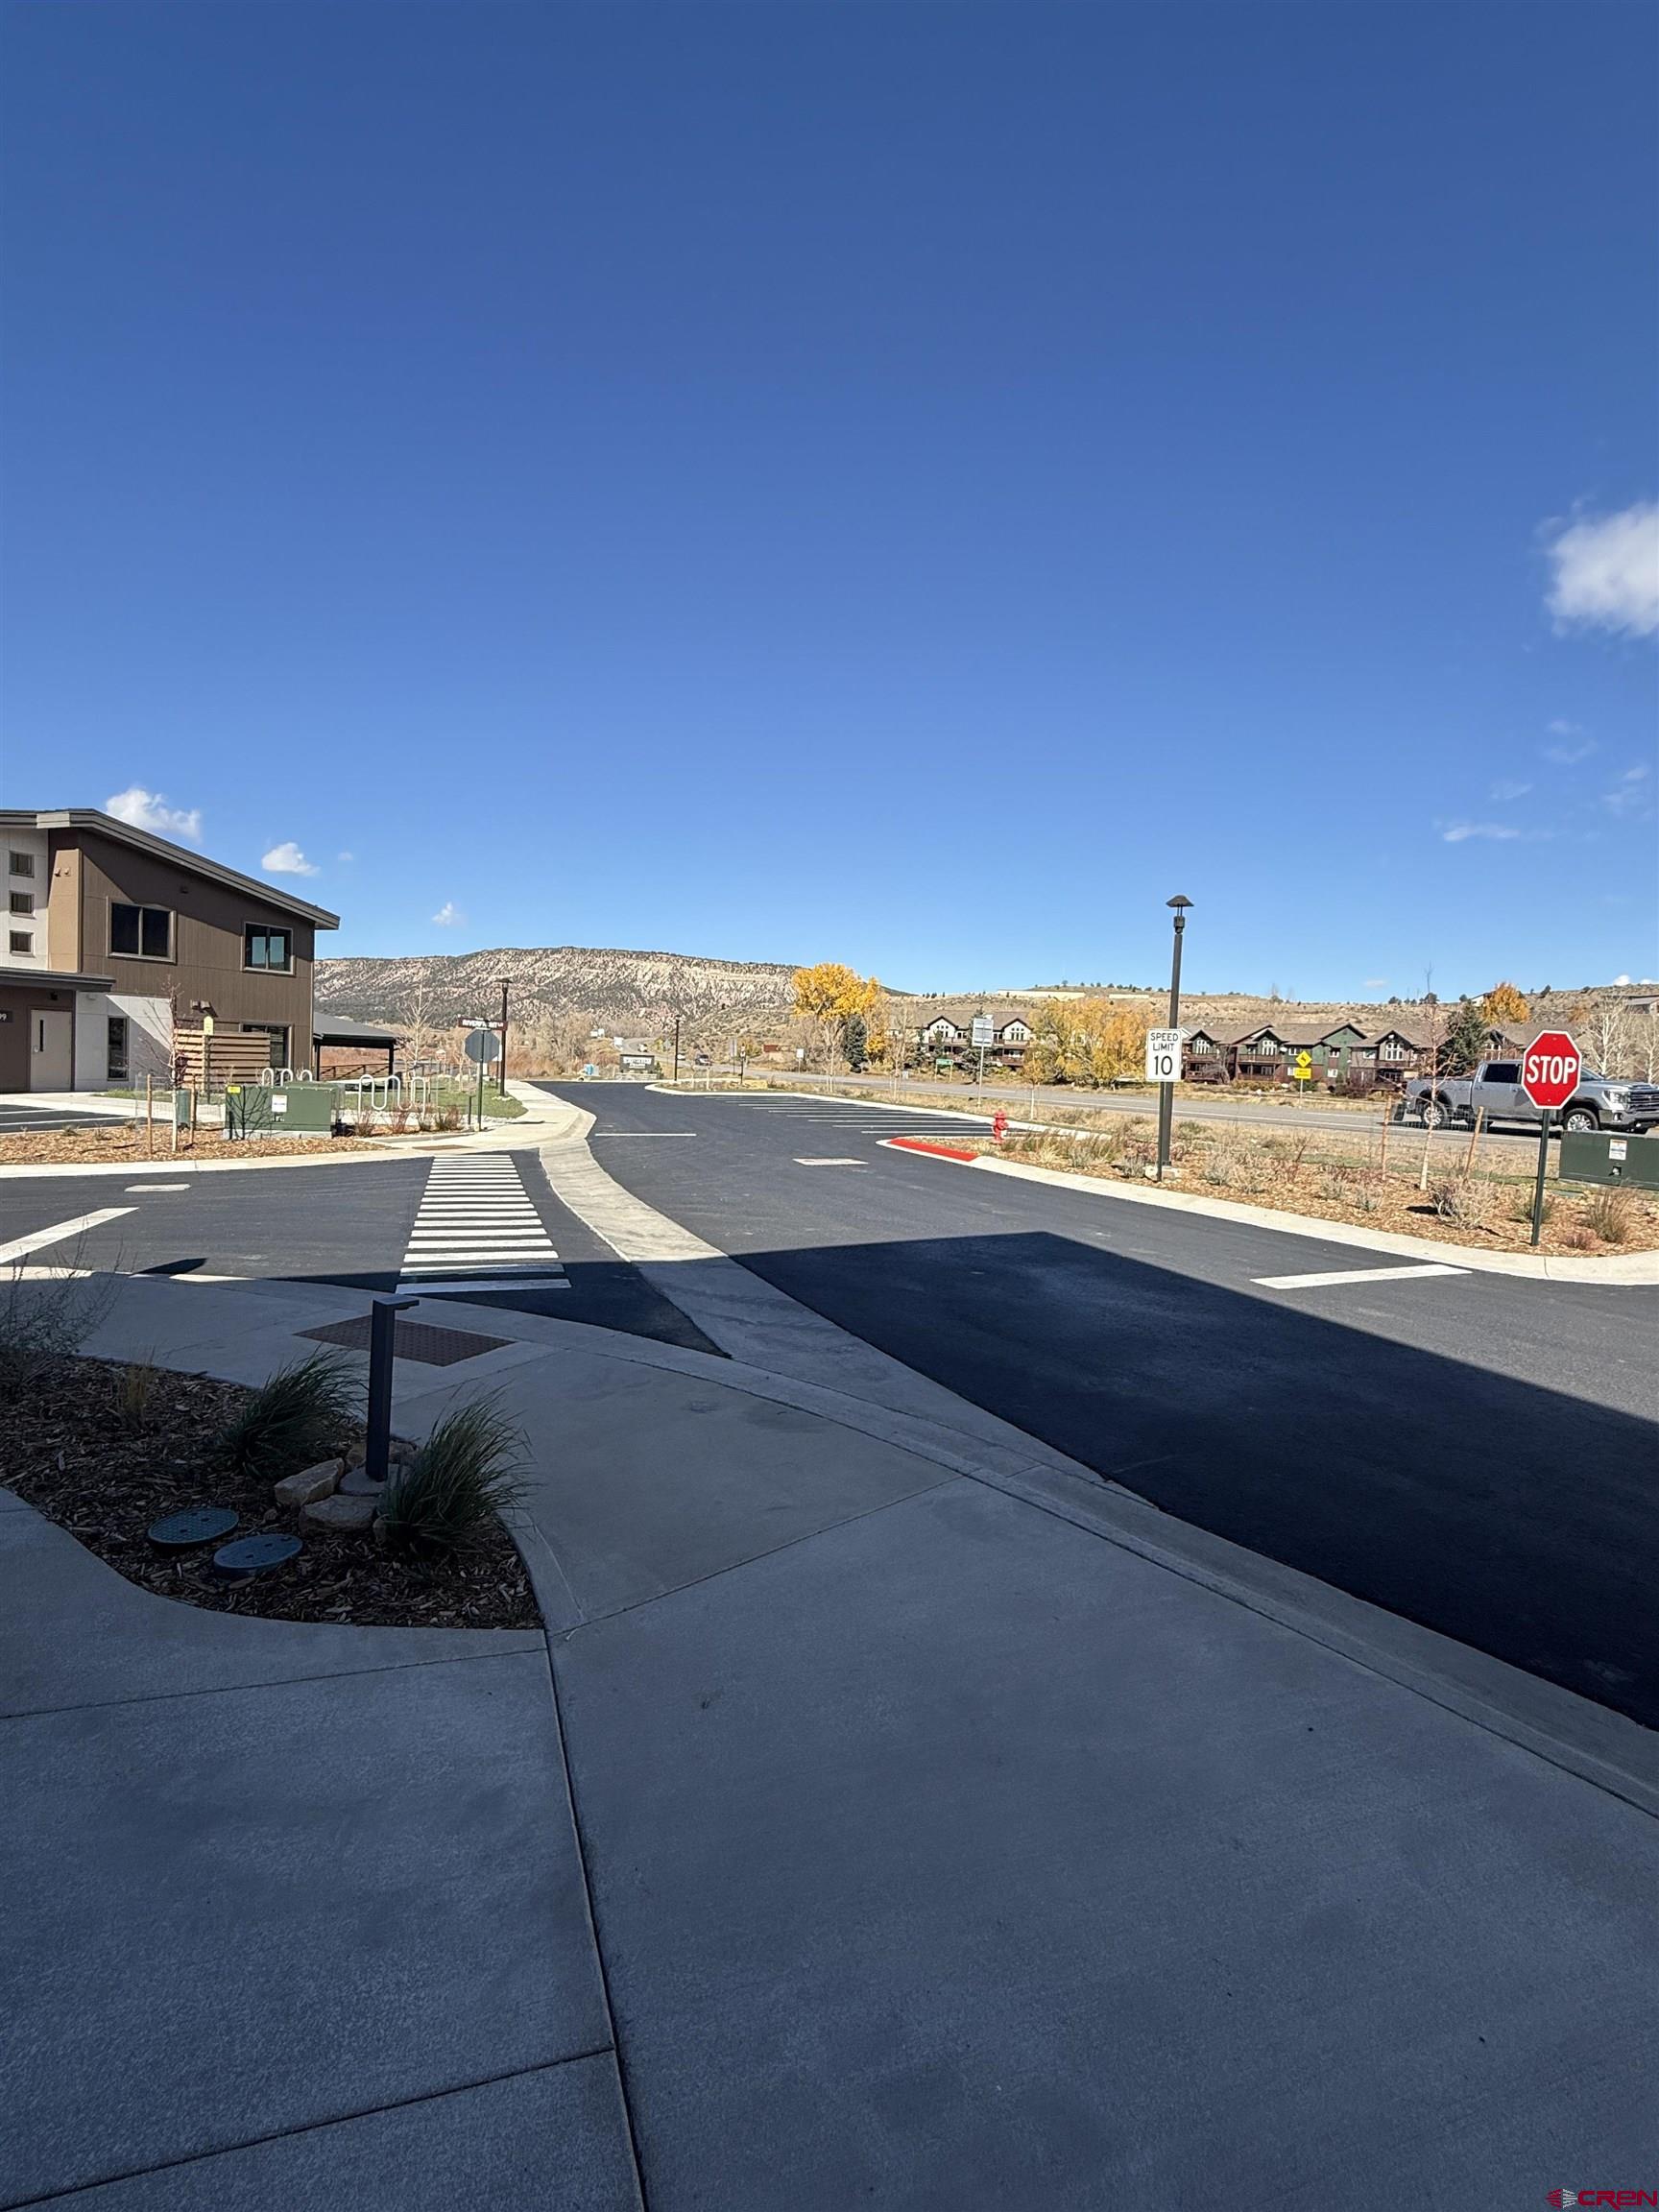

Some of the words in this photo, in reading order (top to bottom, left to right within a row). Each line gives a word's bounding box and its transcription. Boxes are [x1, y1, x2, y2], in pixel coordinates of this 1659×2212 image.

[1150, 1032, 1179, 1042] SPEED
[1152, 1043, 1175, 1051] LIMIT
[1154, 1055, 1173, 1075] 10
[1526, 1054, 1577, 1084] STOP
